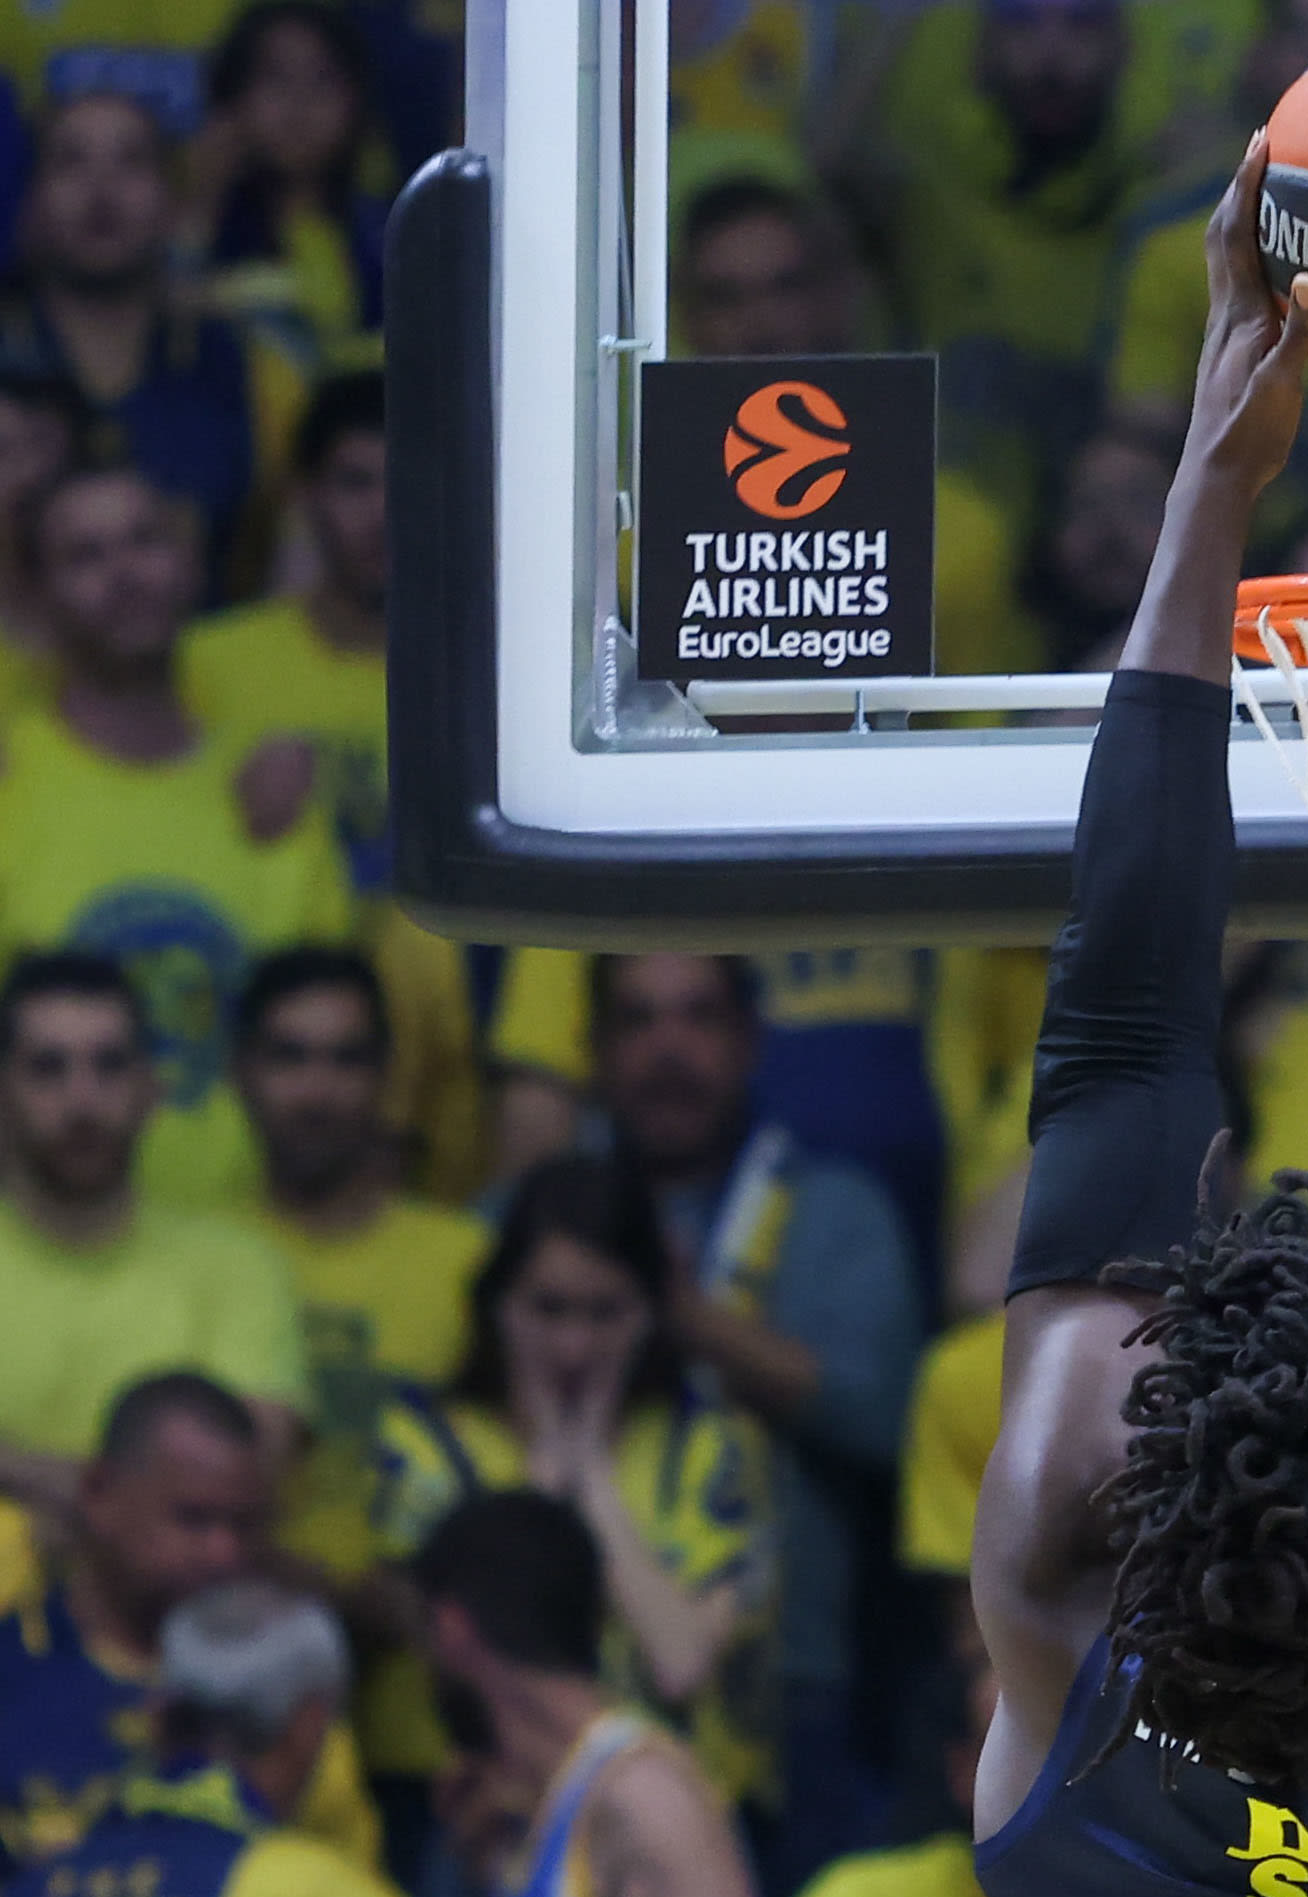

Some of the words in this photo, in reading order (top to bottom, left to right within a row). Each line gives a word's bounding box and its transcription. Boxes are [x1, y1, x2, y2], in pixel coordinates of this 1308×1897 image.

[685, 529, 888, 573] TURKISH
[681, 575, 890, 619] AIRLINES
[678, 623, 891, 668] EuroLeague
